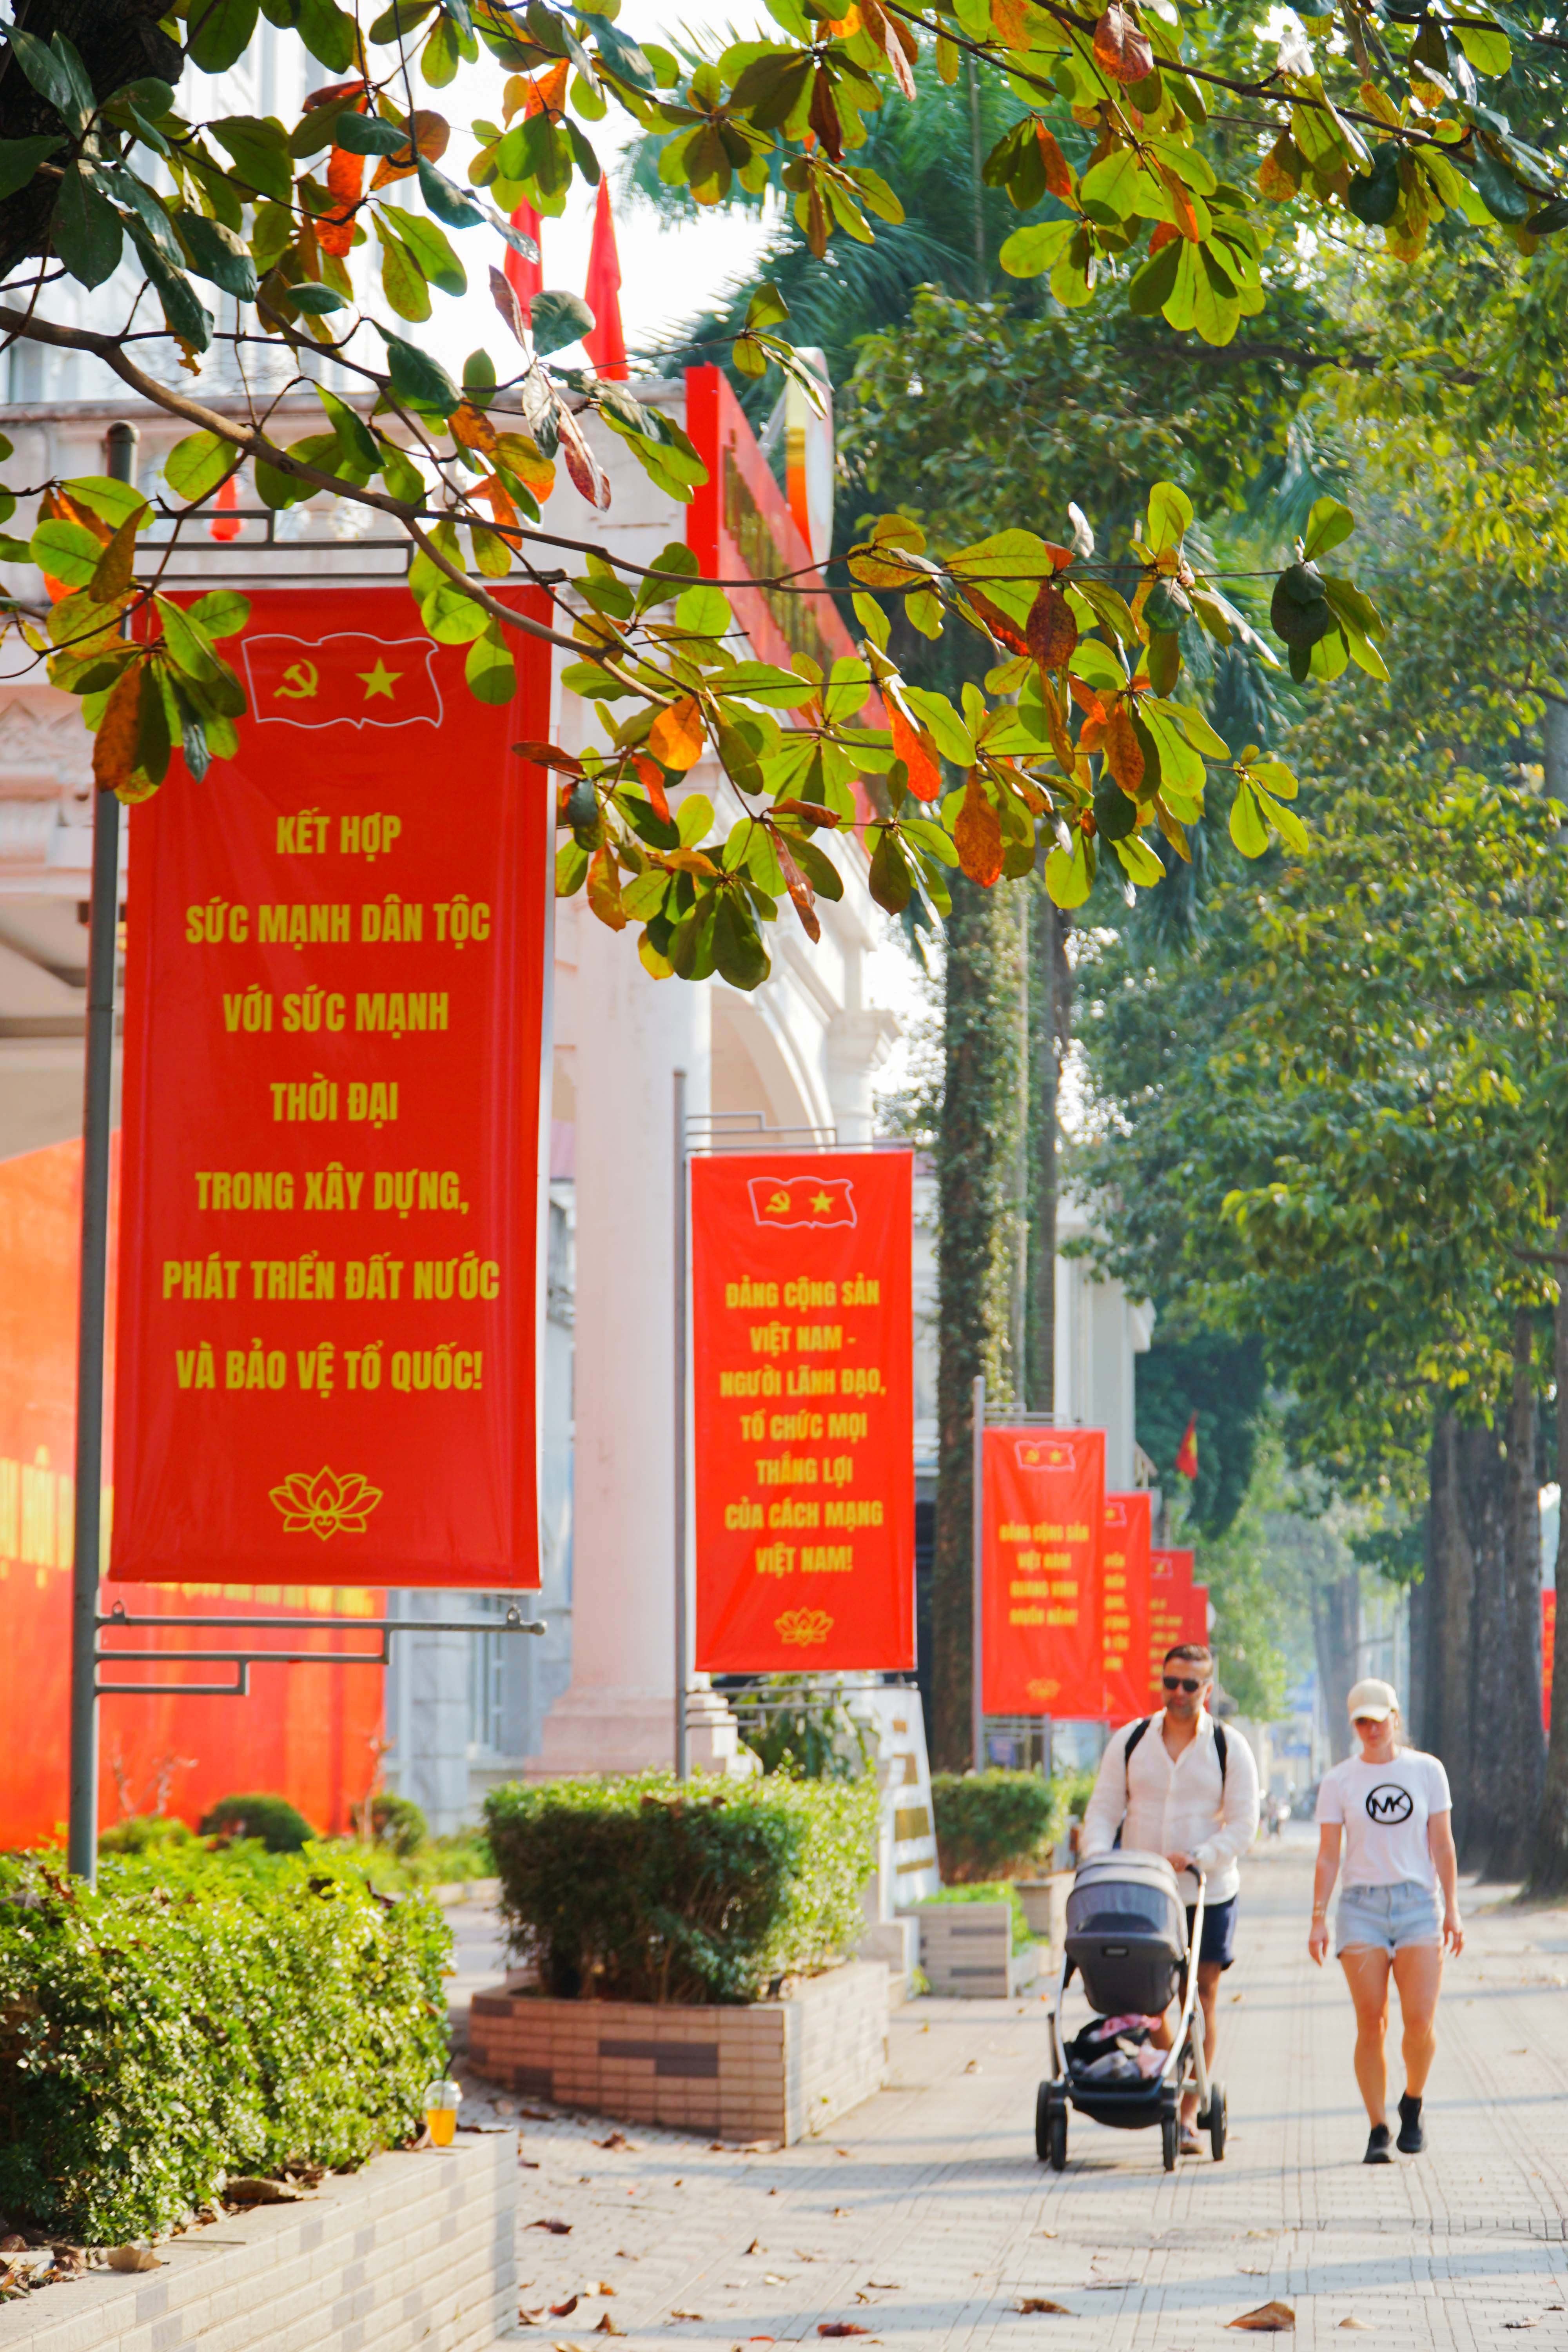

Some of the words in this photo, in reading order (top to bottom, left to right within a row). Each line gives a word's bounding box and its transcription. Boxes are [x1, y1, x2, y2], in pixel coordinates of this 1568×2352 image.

[277, 807, 330, 854] KẾT
[340, 812, 401, 862] HỢP
[185, 896, 249, 944] SỨC
[258, 904, 350, 951] MẠNH
[361, 893, 423, 942] DÂN
[433, 894, 491, 950] TỘC
[223, 983, 272, 1032] VỚI
[282, 984, 345, 1032] SỨC
[356, 992, 448, 1039] MẠNH
[270, 1071, 338, 1122] THỜI
[347, 1082, 398, 1129] ĐẠI
[195, 1171, 294, 1210] TRONG
[303, 1161, 364, 1210] XÂY
[374, 1168, 469, 1219] DỰNG,
[163, 1251, 242, 1300] PHÁT
[250, 1250, 335, 1300] TRIỂN
[345, 1252, 404, 1300] ĐẤT
[413, 1250, 500, 1300] NƯỚC
[725, 1274, 779, 1308] ĐẢNG
[783, 1276, 837, 1312] CỘNG
[842, 1272, 880, 1307] SẢN
[750, 1320, 791, 1357] VIỆT
[796, 1325, 842, 1352] NAM
[175, 1341, 216, 1389] VÀ
[225, 1337, 287, 1390] BẢO
[296, 1341, 335, 1399] VỆ
[343, 1339, 384, 1390] TỔ
[391, 1341, 483, 1393] QUỐC!
[720, 1364, 782, 1397] NGƯỜI
[786, 1365, 836, 1396] LÃNH
[840, 1367, 886, 1399] ĐẠO,
[769, 1408, 824, 1441] CHỨC
[828, 1412, 867, 1444] MỌI
[822, 1455, 853, 1489] LỢI
[724, 1496, 764, 1530] CỦA
[769, 1497, 820, 1529] CÁCH
[824, 1500, 884, 1532] MẠNG
[755, 1541, 796, 1578] VIỆT
[800, 1545, 853, 1573] NAM!
[1371, 1791, 1408, 1817] MK
